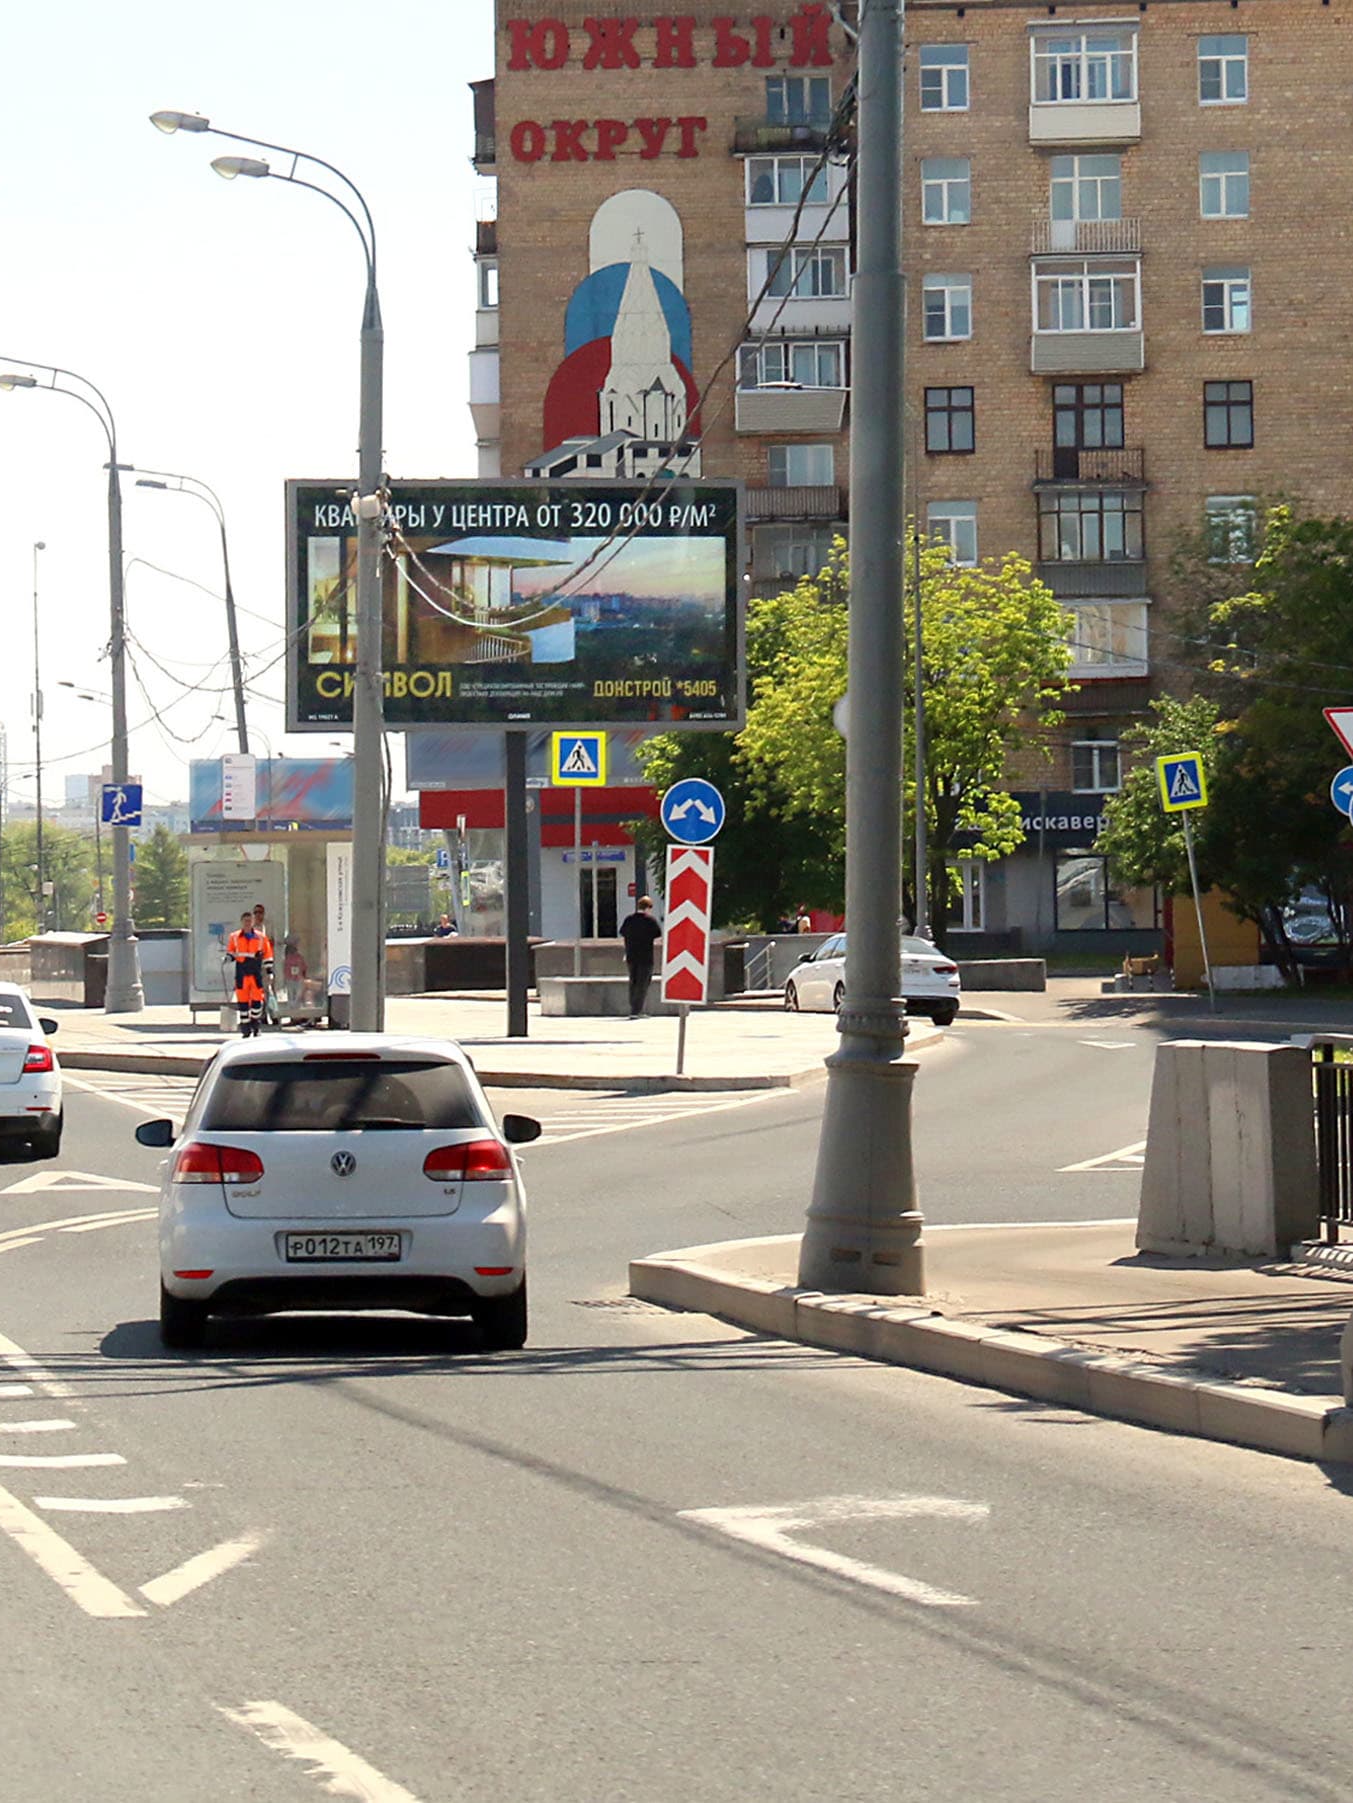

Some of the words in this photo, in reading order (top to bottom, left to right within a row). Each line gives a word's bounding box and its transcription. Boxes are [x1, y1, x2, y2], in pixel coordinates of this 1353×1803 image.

[507, 3, 834, 70] ЮЖНЫЙ
[509, 116, 708, 163] ОКРУГ
[314, 504, 425, 528] КВАРЫ
[433, 505, 445, 527] У
[452, 504, 529, 531] ЦЕНТРА
[536, 504, 562, 527] ОТ
[570, 503, 611, 527] 320
[619, 503, 663, 527] 000
[316, 671, 453, 698] СИВОЛ
[593, 677, 672, 697] ДОНСТРОЙ
[1017, 815, 1110, 832] искавер
[292, 1238, 363, 1256] Р012ТА
[367, 1236, 395, 1250] 197
